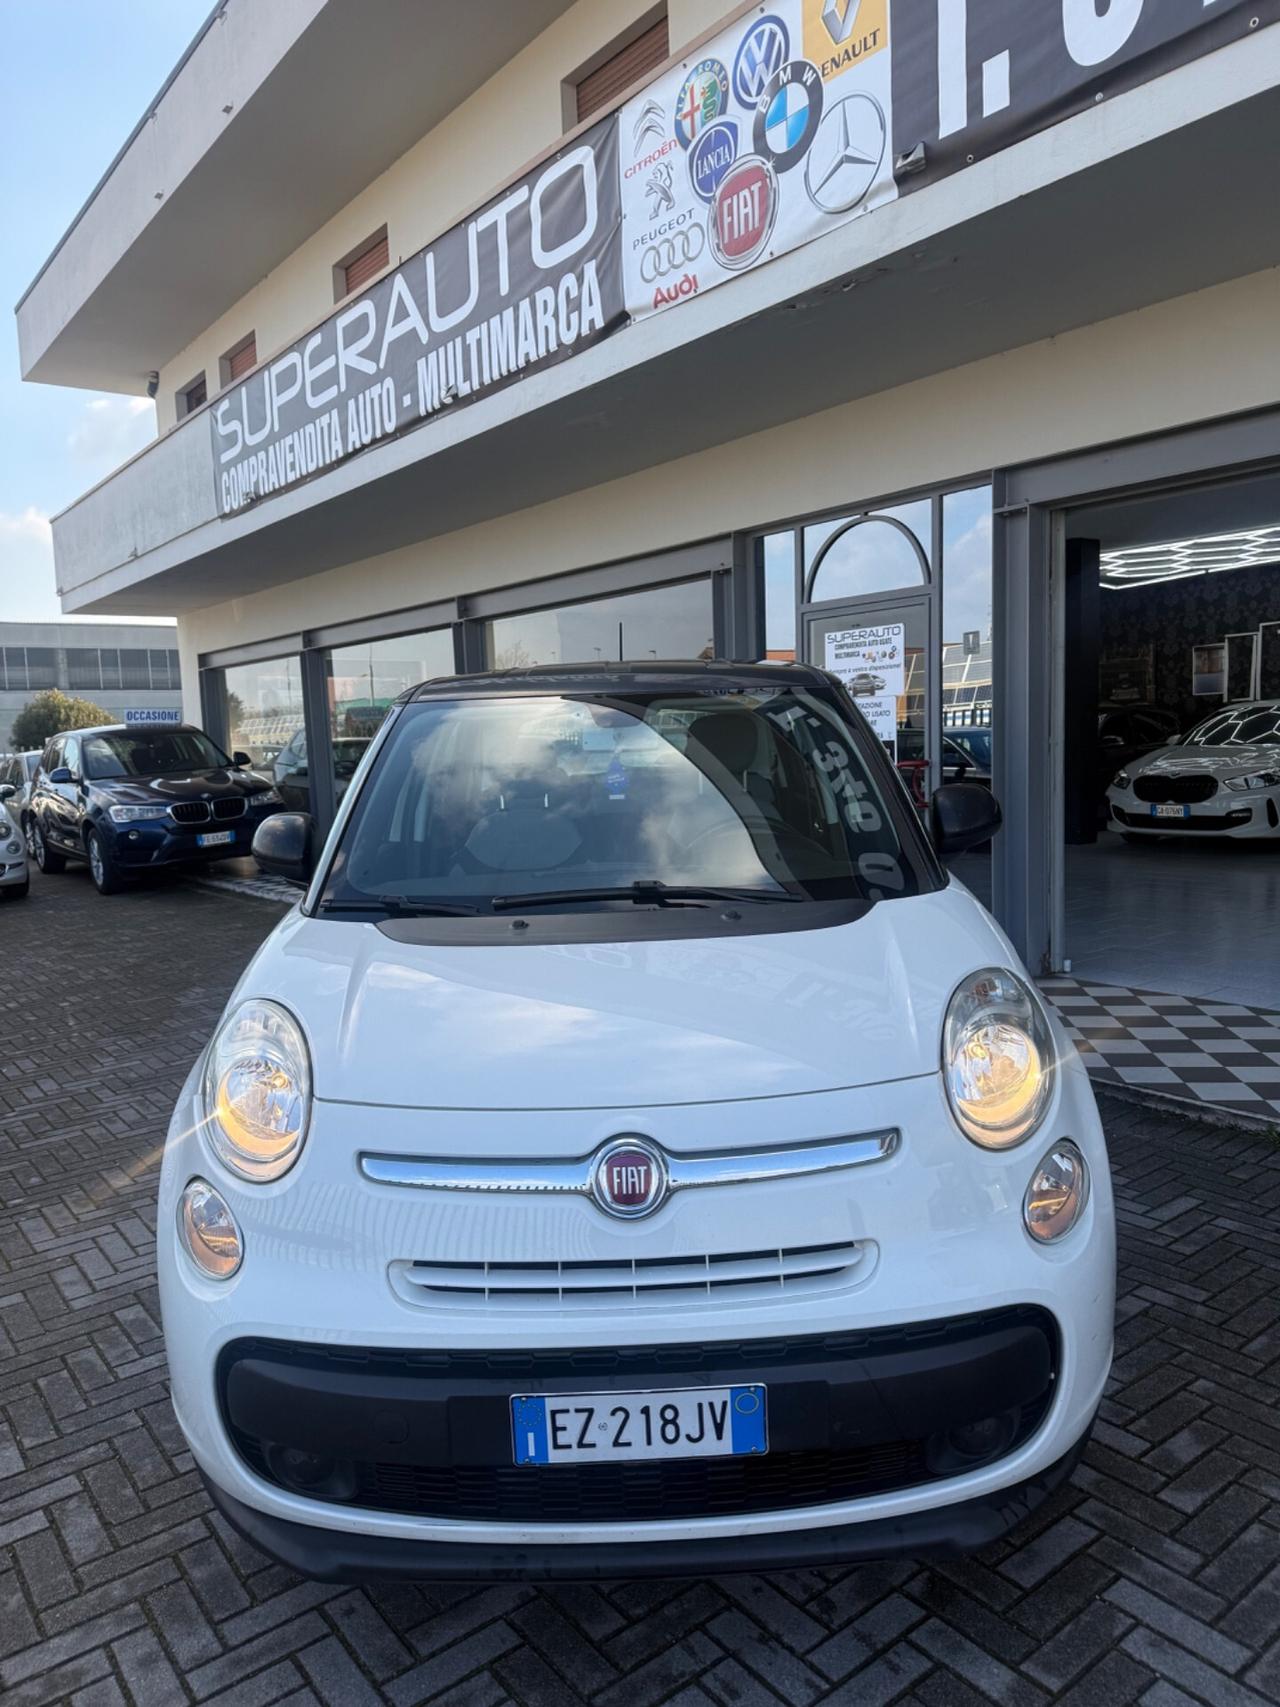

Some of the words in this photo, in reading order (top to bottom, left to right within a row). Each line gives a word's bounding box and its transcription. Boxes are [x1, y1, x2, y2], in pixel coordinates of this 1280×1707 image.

[819, 28, 881, 77] ENAULT
[759, 65, 816, 114] BMW
[697, 144, 731, 178] LANCIA
[632, 208, 695, 250] PEUGEOT
[722, 181, 763, 245] FIAT
[216, 145, 599, 465] SUPERAUTO
[221, 407, 343, 514] COMPRAVENDITA
[347, 377, 398, 449] AUTO
[416, 259, 605, 417] MULTIMARCA
[827, 625, 901, 644] SUPERAUTO
[126, 711, 179, 721] OCCASIONE
[612, 1165, 648, 1196] FIAT
[550, 1408, 597, 1450] EZ
[609, 1400, 728, 1447] 218JV
